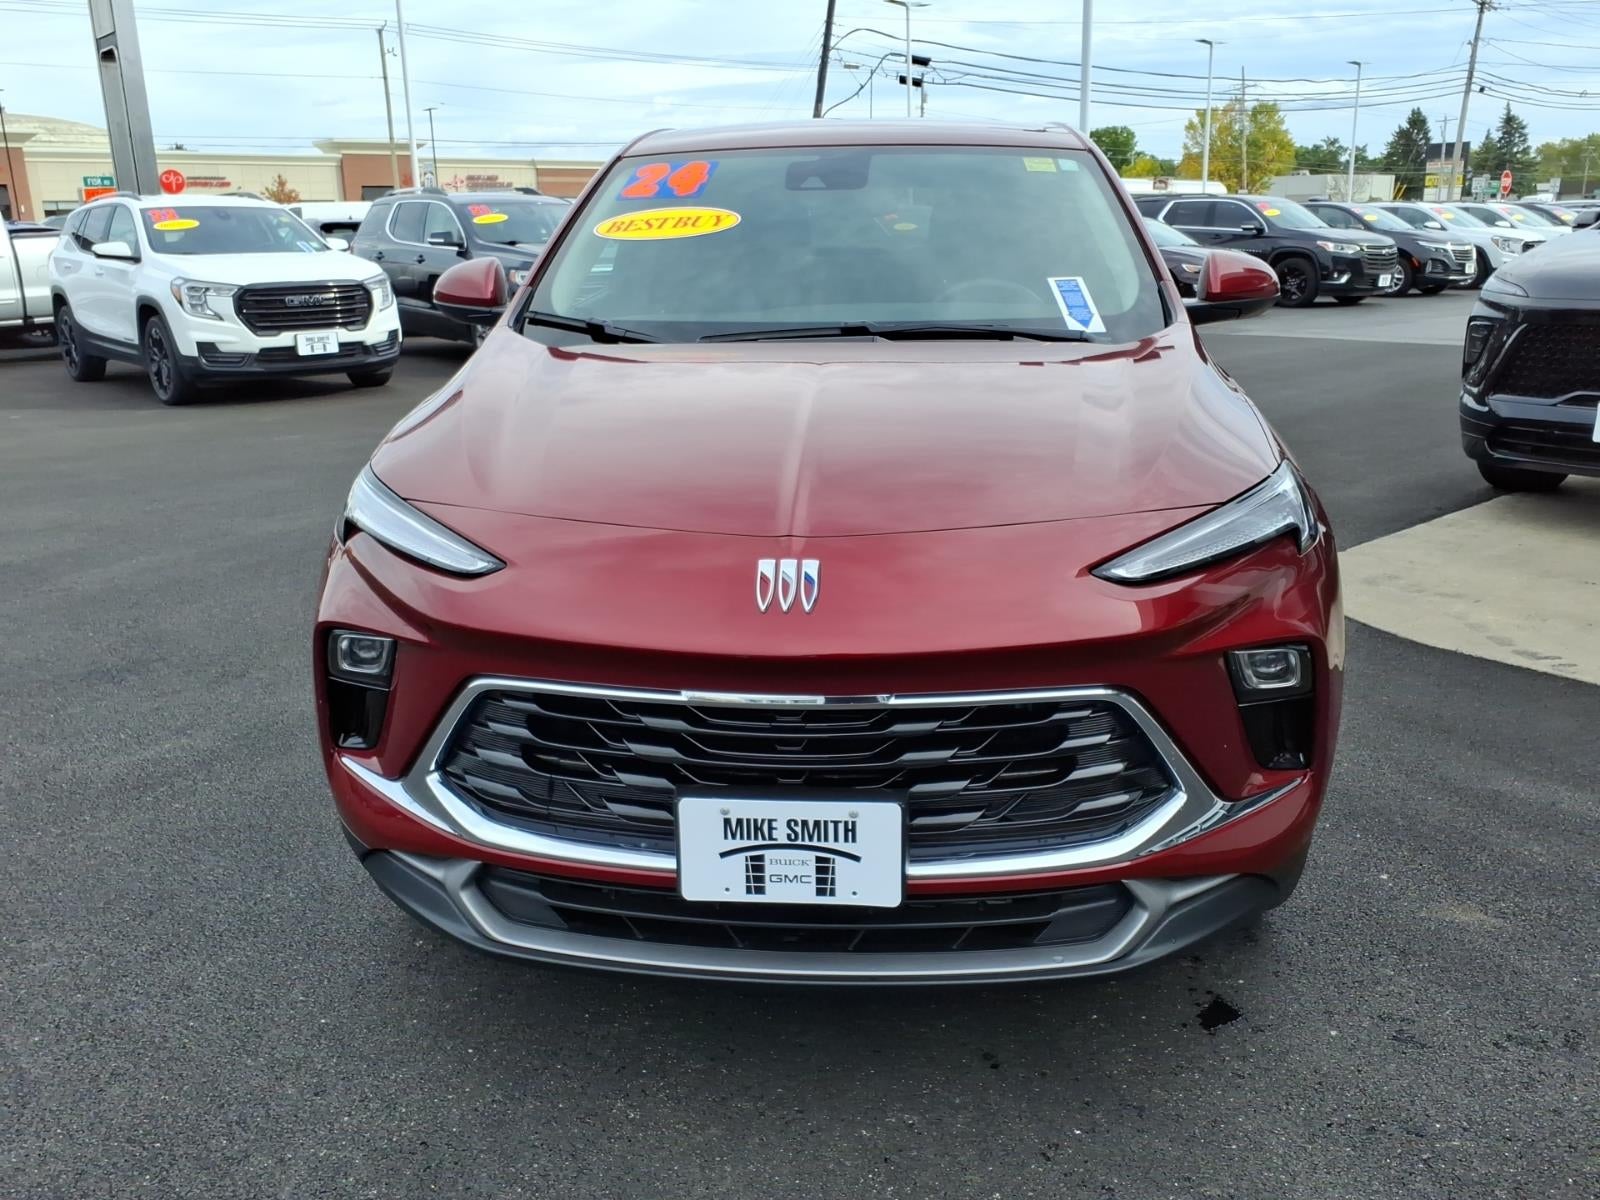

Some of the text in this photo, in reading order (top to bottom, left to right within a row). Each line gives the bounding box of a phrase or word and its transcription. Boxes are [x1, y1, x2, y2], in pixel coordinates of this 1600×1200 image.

[621, 160, 710, 198] 24
[606, 213, 731, 234] BEST BUY
[722, 817, 858, 843] MIKE SMITH
[769, 858, 811, 867] BUICK
[769, 874, 812, 884] GMC
